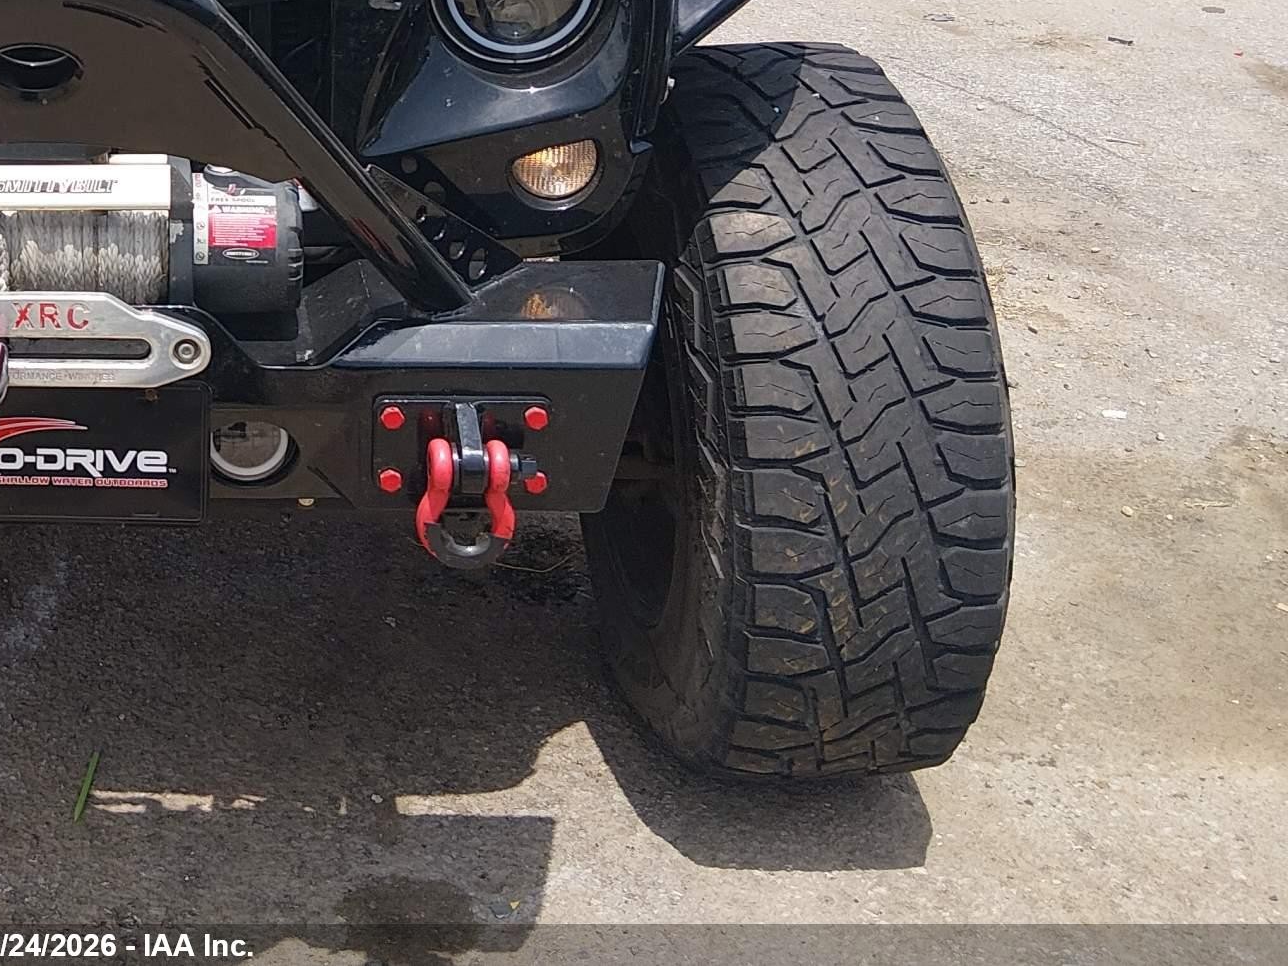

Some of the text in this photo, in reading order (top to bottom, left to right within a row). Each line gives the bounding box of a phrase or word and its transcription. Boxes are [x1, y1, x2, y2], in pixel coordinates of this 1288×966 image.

[12, 302, 90, 330] XRC
[51, 476, 94, 486] WATER
[95, 477, 168, 488] OUTBOARDS
